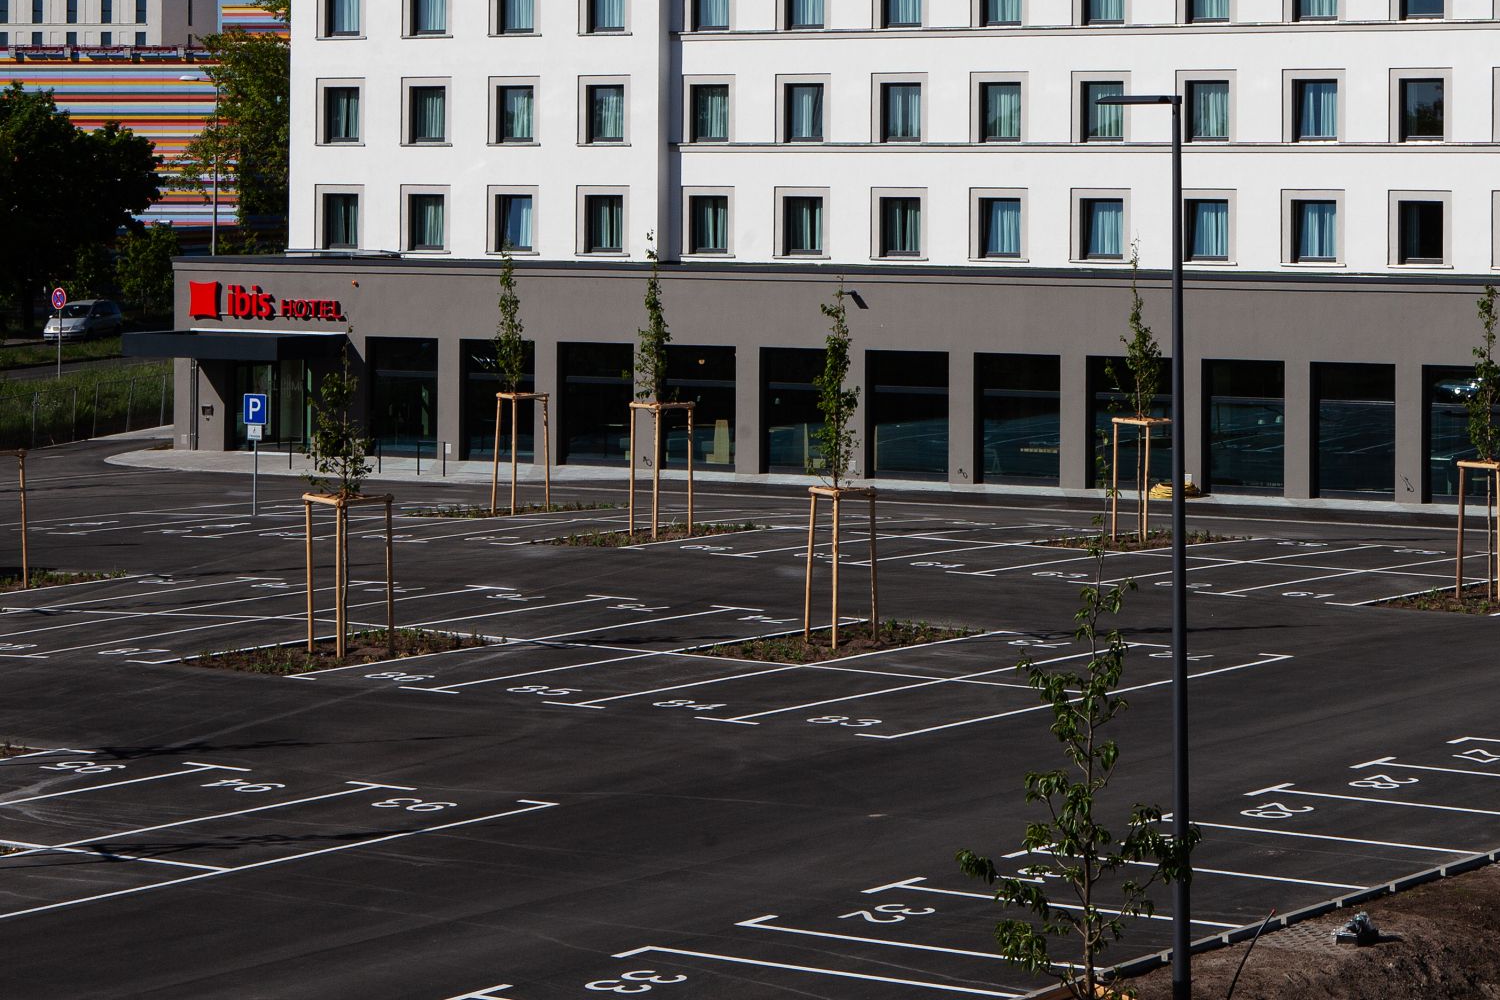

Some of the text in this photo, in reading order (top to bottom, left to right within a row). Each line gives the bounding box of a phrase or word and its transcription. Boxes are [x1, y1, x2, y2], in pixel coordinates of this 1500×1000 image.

[227, 284, 342, 319] ibis HOTEL
[249, 397, 261, 420] P
[652, 699, 727, 711] 84
[806, 715, 883, 727] 83
[39, 761, 127, 774] 95
[200, 778, 286, 793] 94
[1348, 774, 1420, 790] 28
[371, 797, 458, 812] 93
[1239, 802, 1315, 819] 29
[837, 903, 936, 924] 32
[584, 969, 688, 994] 33
